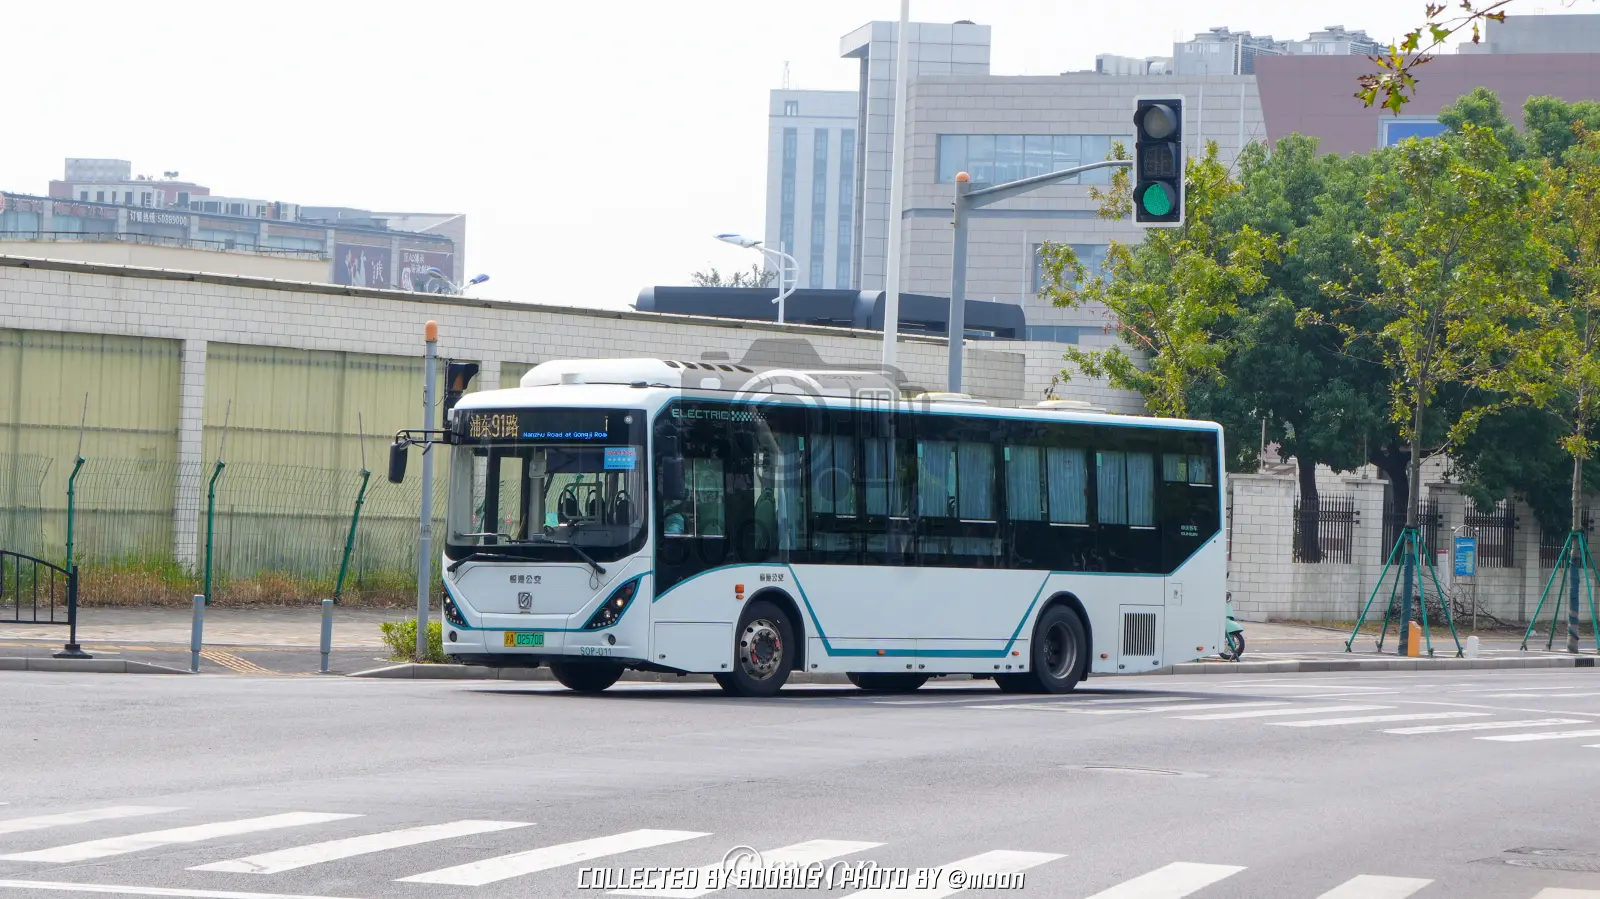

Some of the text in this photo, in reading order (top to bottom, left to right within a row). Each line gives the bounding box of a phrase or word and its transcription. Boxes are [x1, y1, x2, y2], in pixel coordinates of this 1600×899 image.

[671, 408, 728, 420] ELECTRIC
[470, 414, 519, 437] 浦东91路
